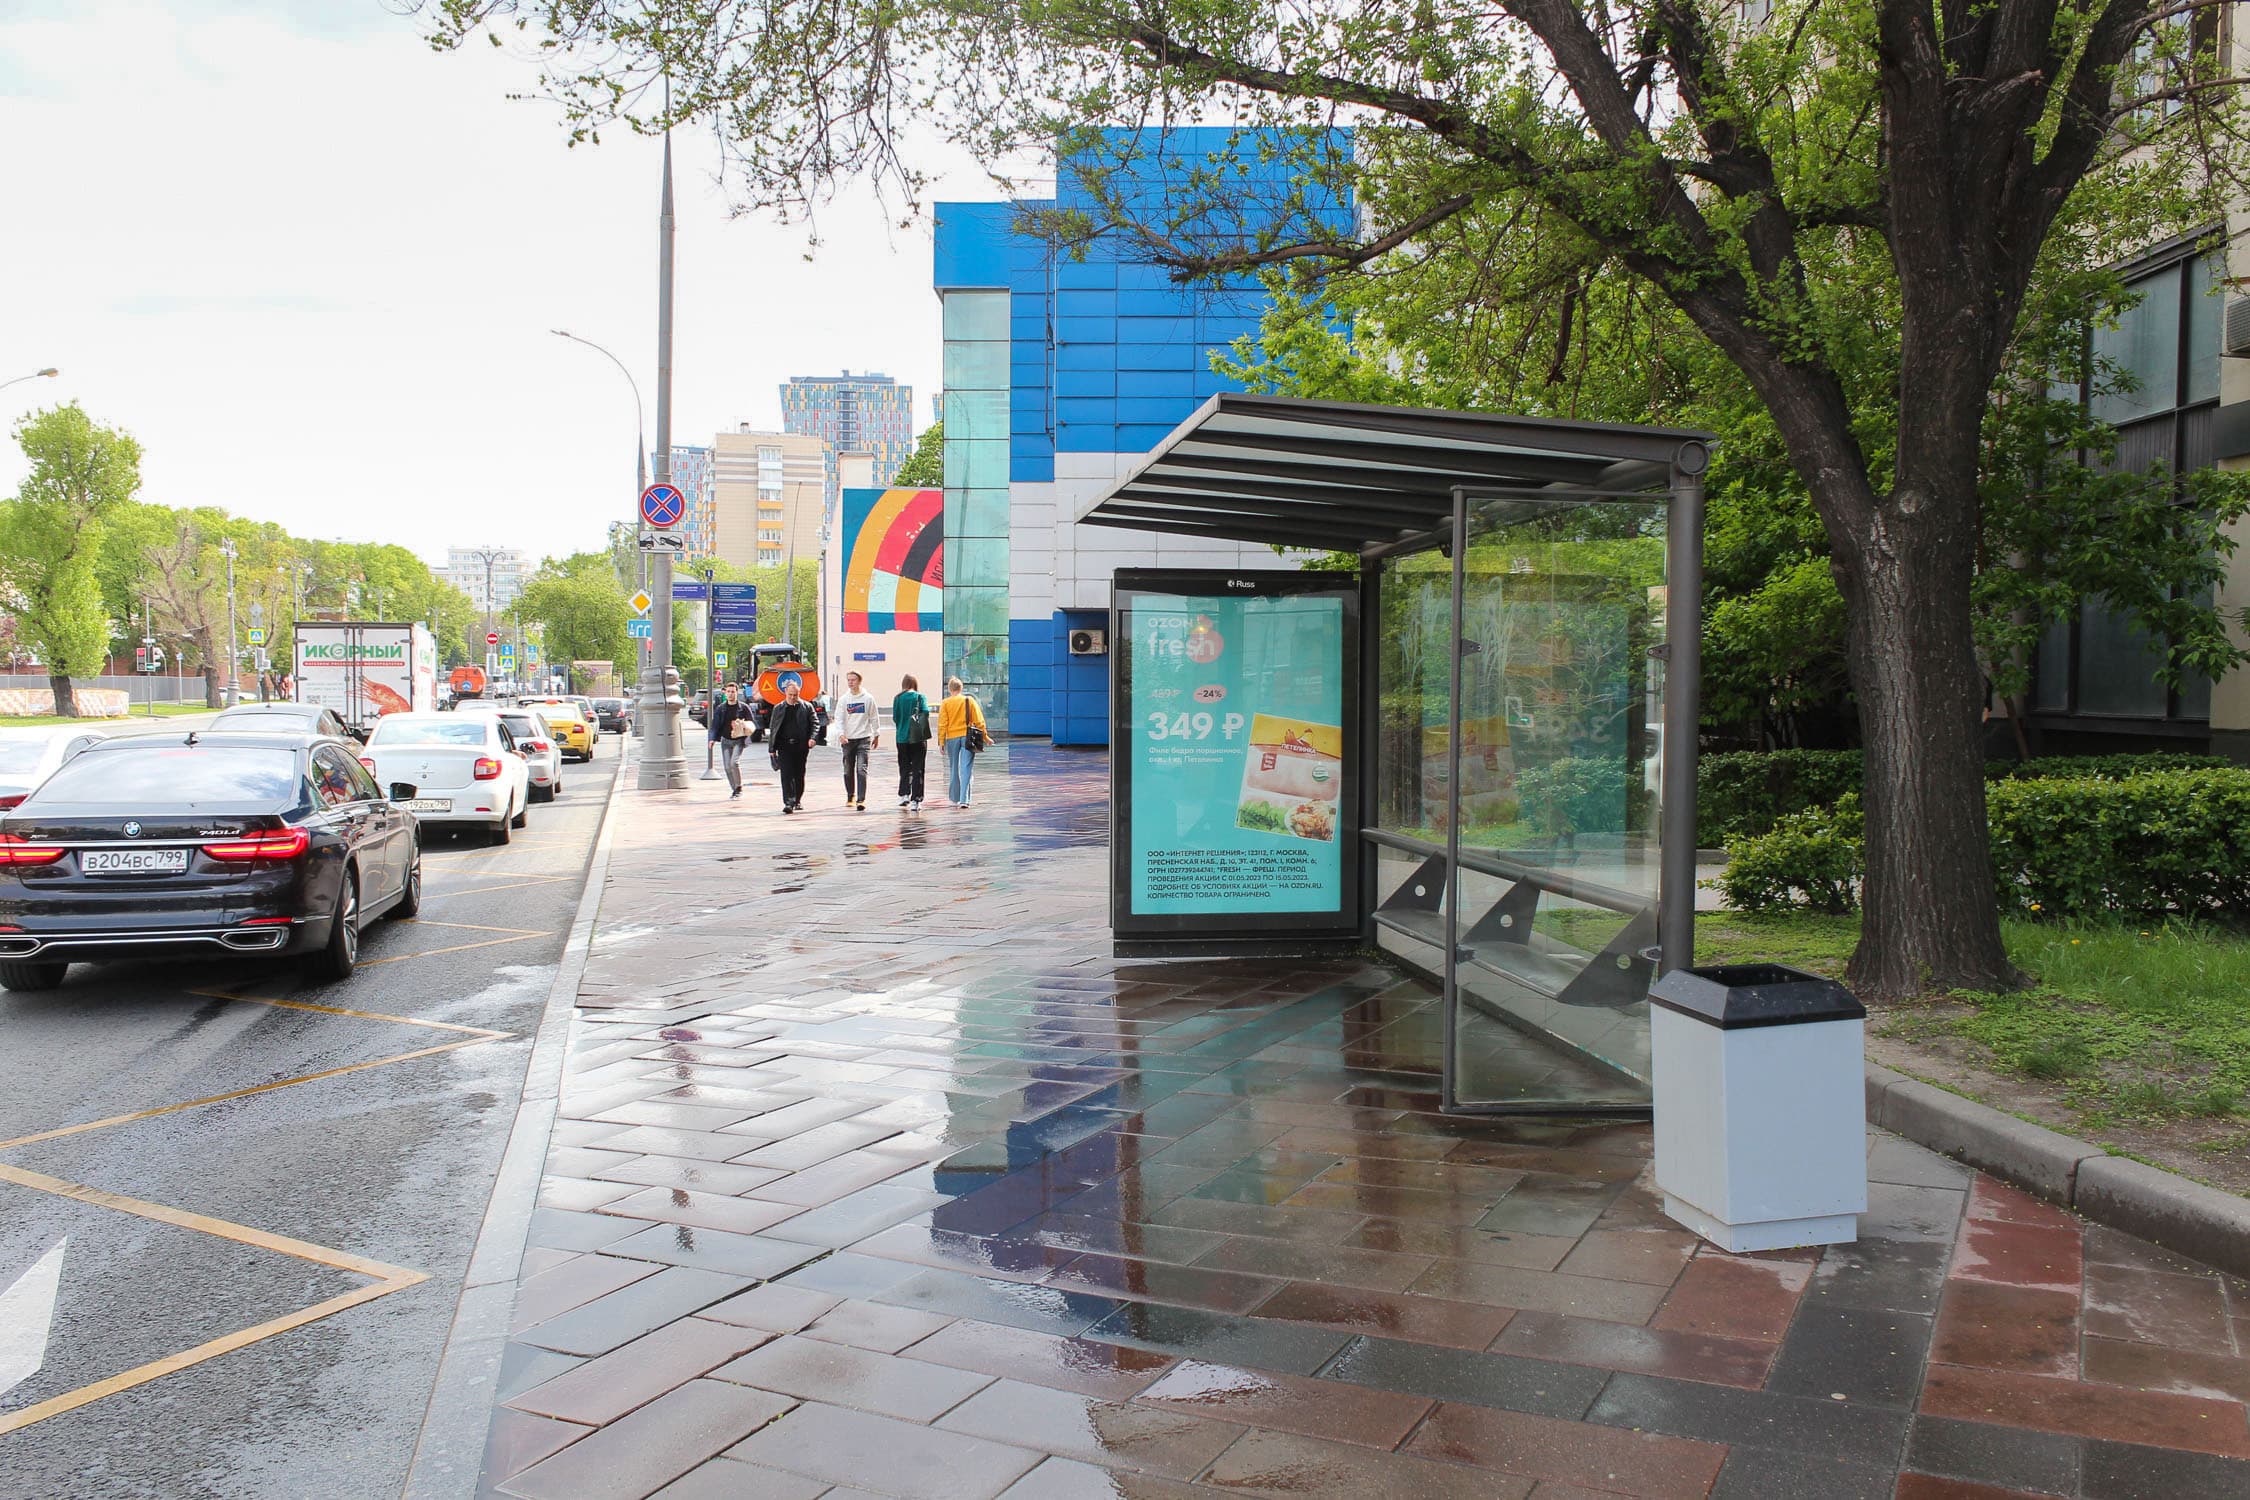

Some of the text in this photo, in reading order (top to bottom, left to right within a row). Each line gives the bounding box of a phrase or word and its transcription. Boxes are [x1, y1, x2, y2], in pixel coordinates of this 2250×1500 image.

[1236, 580, 1255, 588] Russ
[305, 641, 402, 659] ИКОРНЫЙ
[1148, 631, 1215, 656] fresh
[1148, 712, 1214, 740] 349
[88, 851, 183, 869] В204ВС 799
[1276, 849, 1309, 857] МОСКВА,
